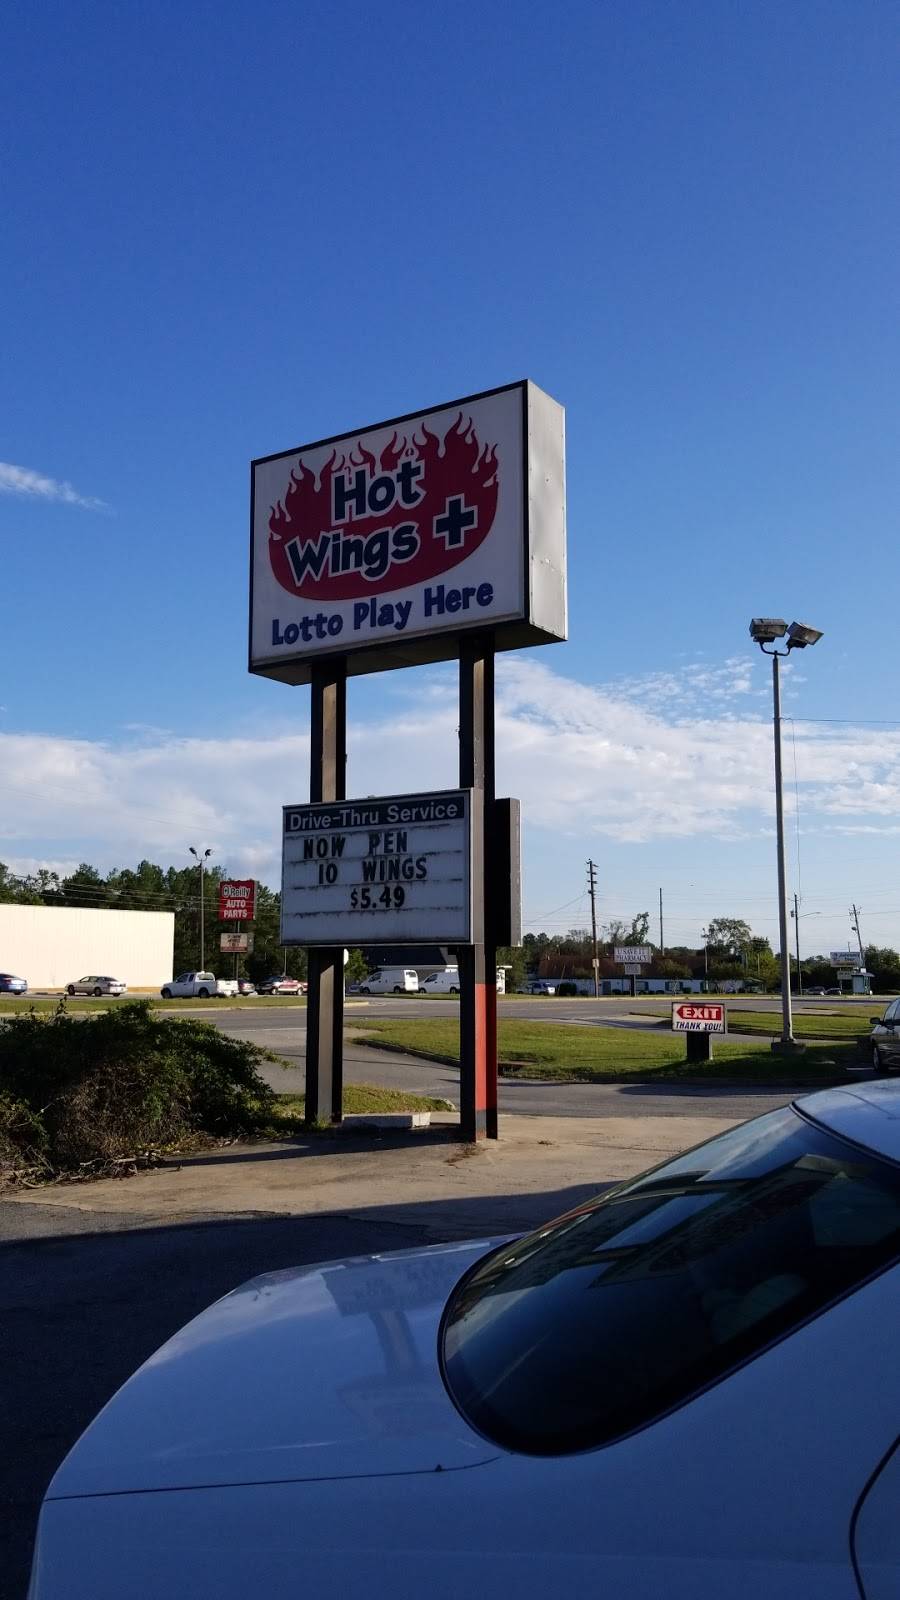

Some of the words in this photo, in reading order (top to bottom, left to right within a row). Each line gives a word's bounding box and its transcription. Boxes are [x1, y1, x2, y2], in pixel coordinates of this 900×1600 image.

[333, 460, 424, 524] Hot
[286, 522, 420, 586] Wings
[271, 612, 343, 646] Lotto
[353, 597, 413, 630] Play
[424, 582, 494, 617] Here
[289, 808, 379, 831] Drive-Thru
[386, 801, 458, 824] Service
[303, 836, 346, 860] NOW
[368, 831, 408, 854] PEN
[318, 863, 338, 885] 10
[362, 856, 428, 882] WINGS
[223, 885, 250, 899] O'Reilly
[225, 899, 246, 908] AUTO
[350, 886, 405, 909] $5.49
[223, 909, 248, 919] PARTS
[676, 1021, 702, 1030] THANK
[704, 1022, 722, 1031] YOU!
[682, 1007, 719, 1019] EXIT
